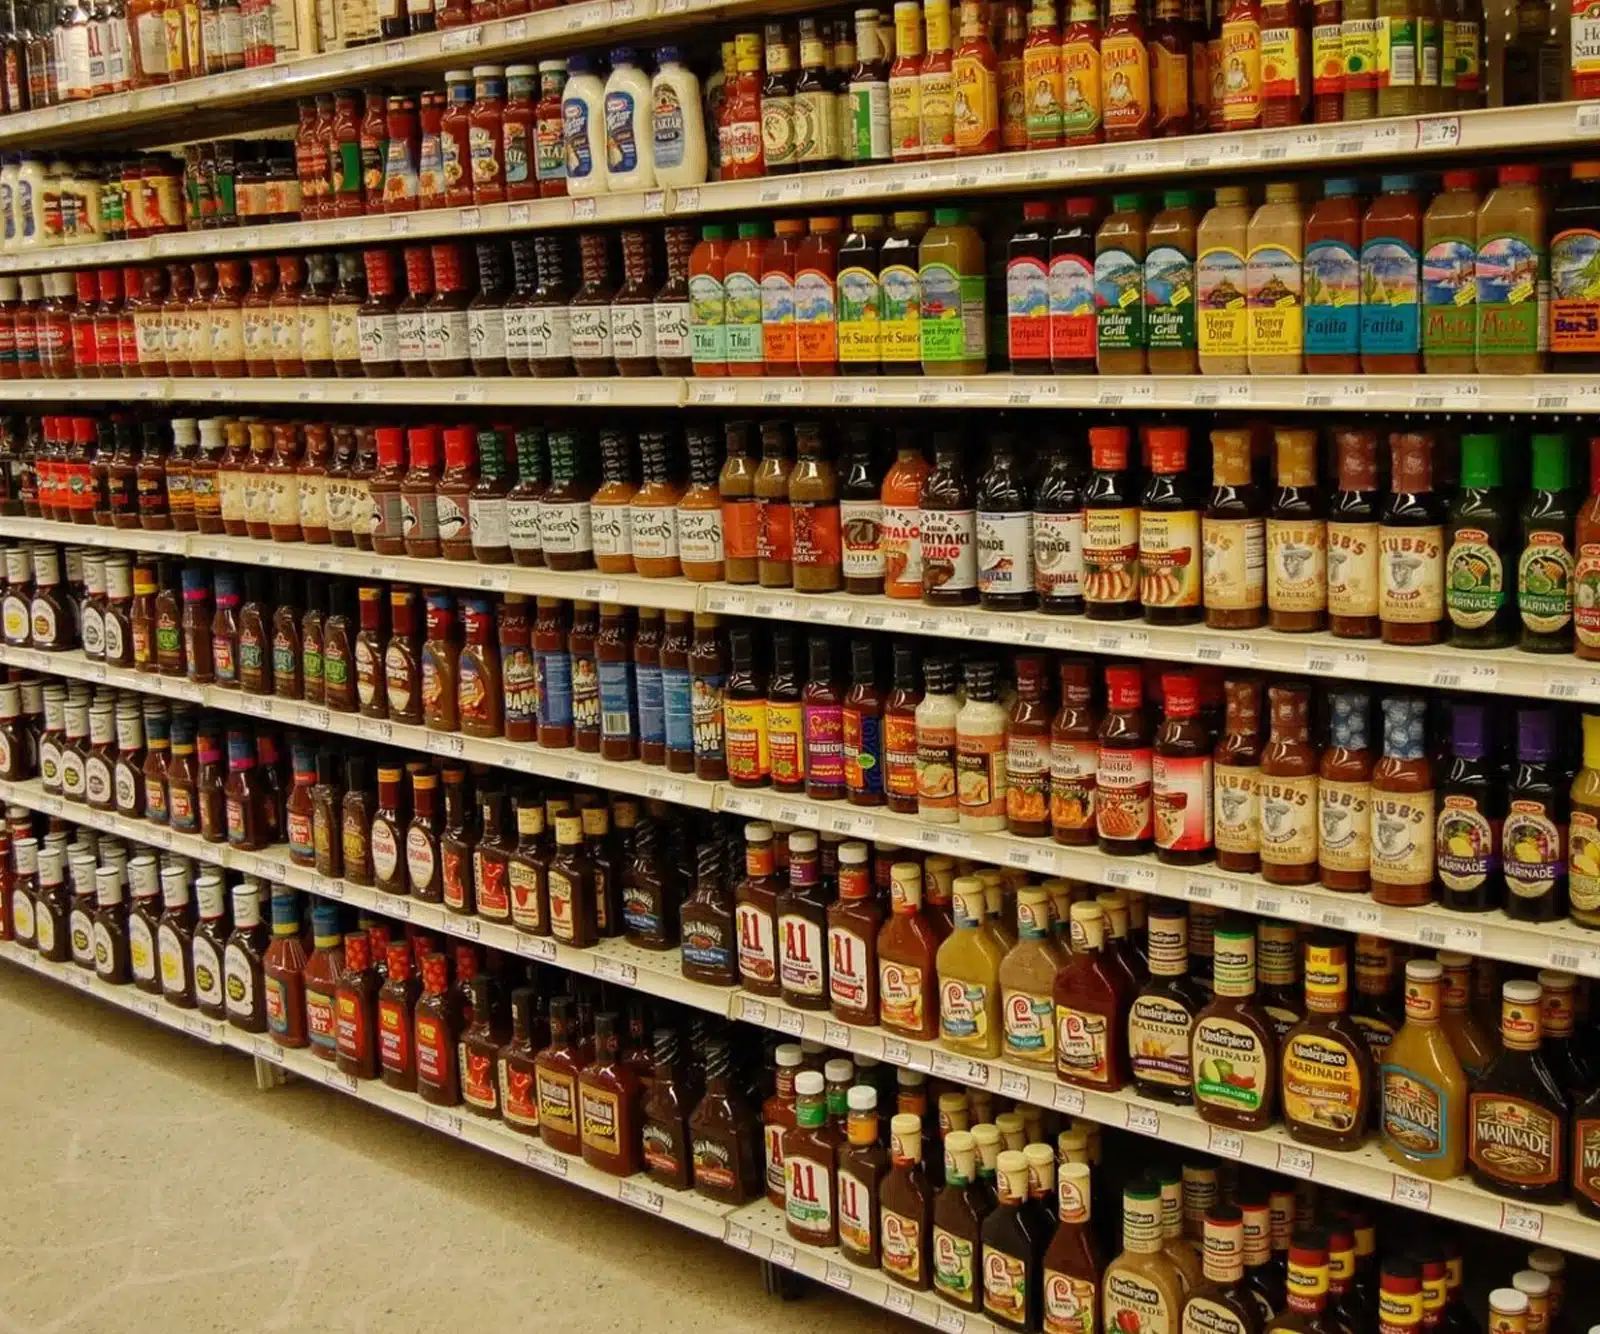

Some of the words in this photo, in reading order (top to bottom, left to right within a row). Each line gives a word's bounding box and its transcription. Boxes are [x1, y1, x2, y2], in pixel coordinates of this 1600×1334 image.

[1436, 124, 1458, 140] .79
[1148, 312, 1184, 326] Italian
[1306, 318, 1348, 337] Fajita
[1362, 316, 1404, 335] Fajita
[1102, 324, 1126, 336] Grill
[1153, 324, 1179, 336] Grill
[694, 333, 716, 348] Thai
[730, 333, 752, 347] Thai
[921, 545, 961, 559] WING
[1519, 598, 1571, 614] MARINADE
[1438, 857, 1488, 874] MARINADE
[1503, 862, 1555, 879] MARINADE
[1136, 1002, 1188, 1025] Masterpiece
[1201, 1028, 1253, 1050] Masterpiece
[1195, 1042, 1261, 1064] MARINADE
[1293, 1042, 1347, 1066] Masterpiece
[968, 1061, 990, 1080] 2.79
[1287, 1058, 1351, 1082] MARINADE
[1311, 1085, 1350, 1102] Balsamic
[1384, 1092, 1438, 1134] MARINADE
[1477, 1121, 1551, 1158] MARINADE
